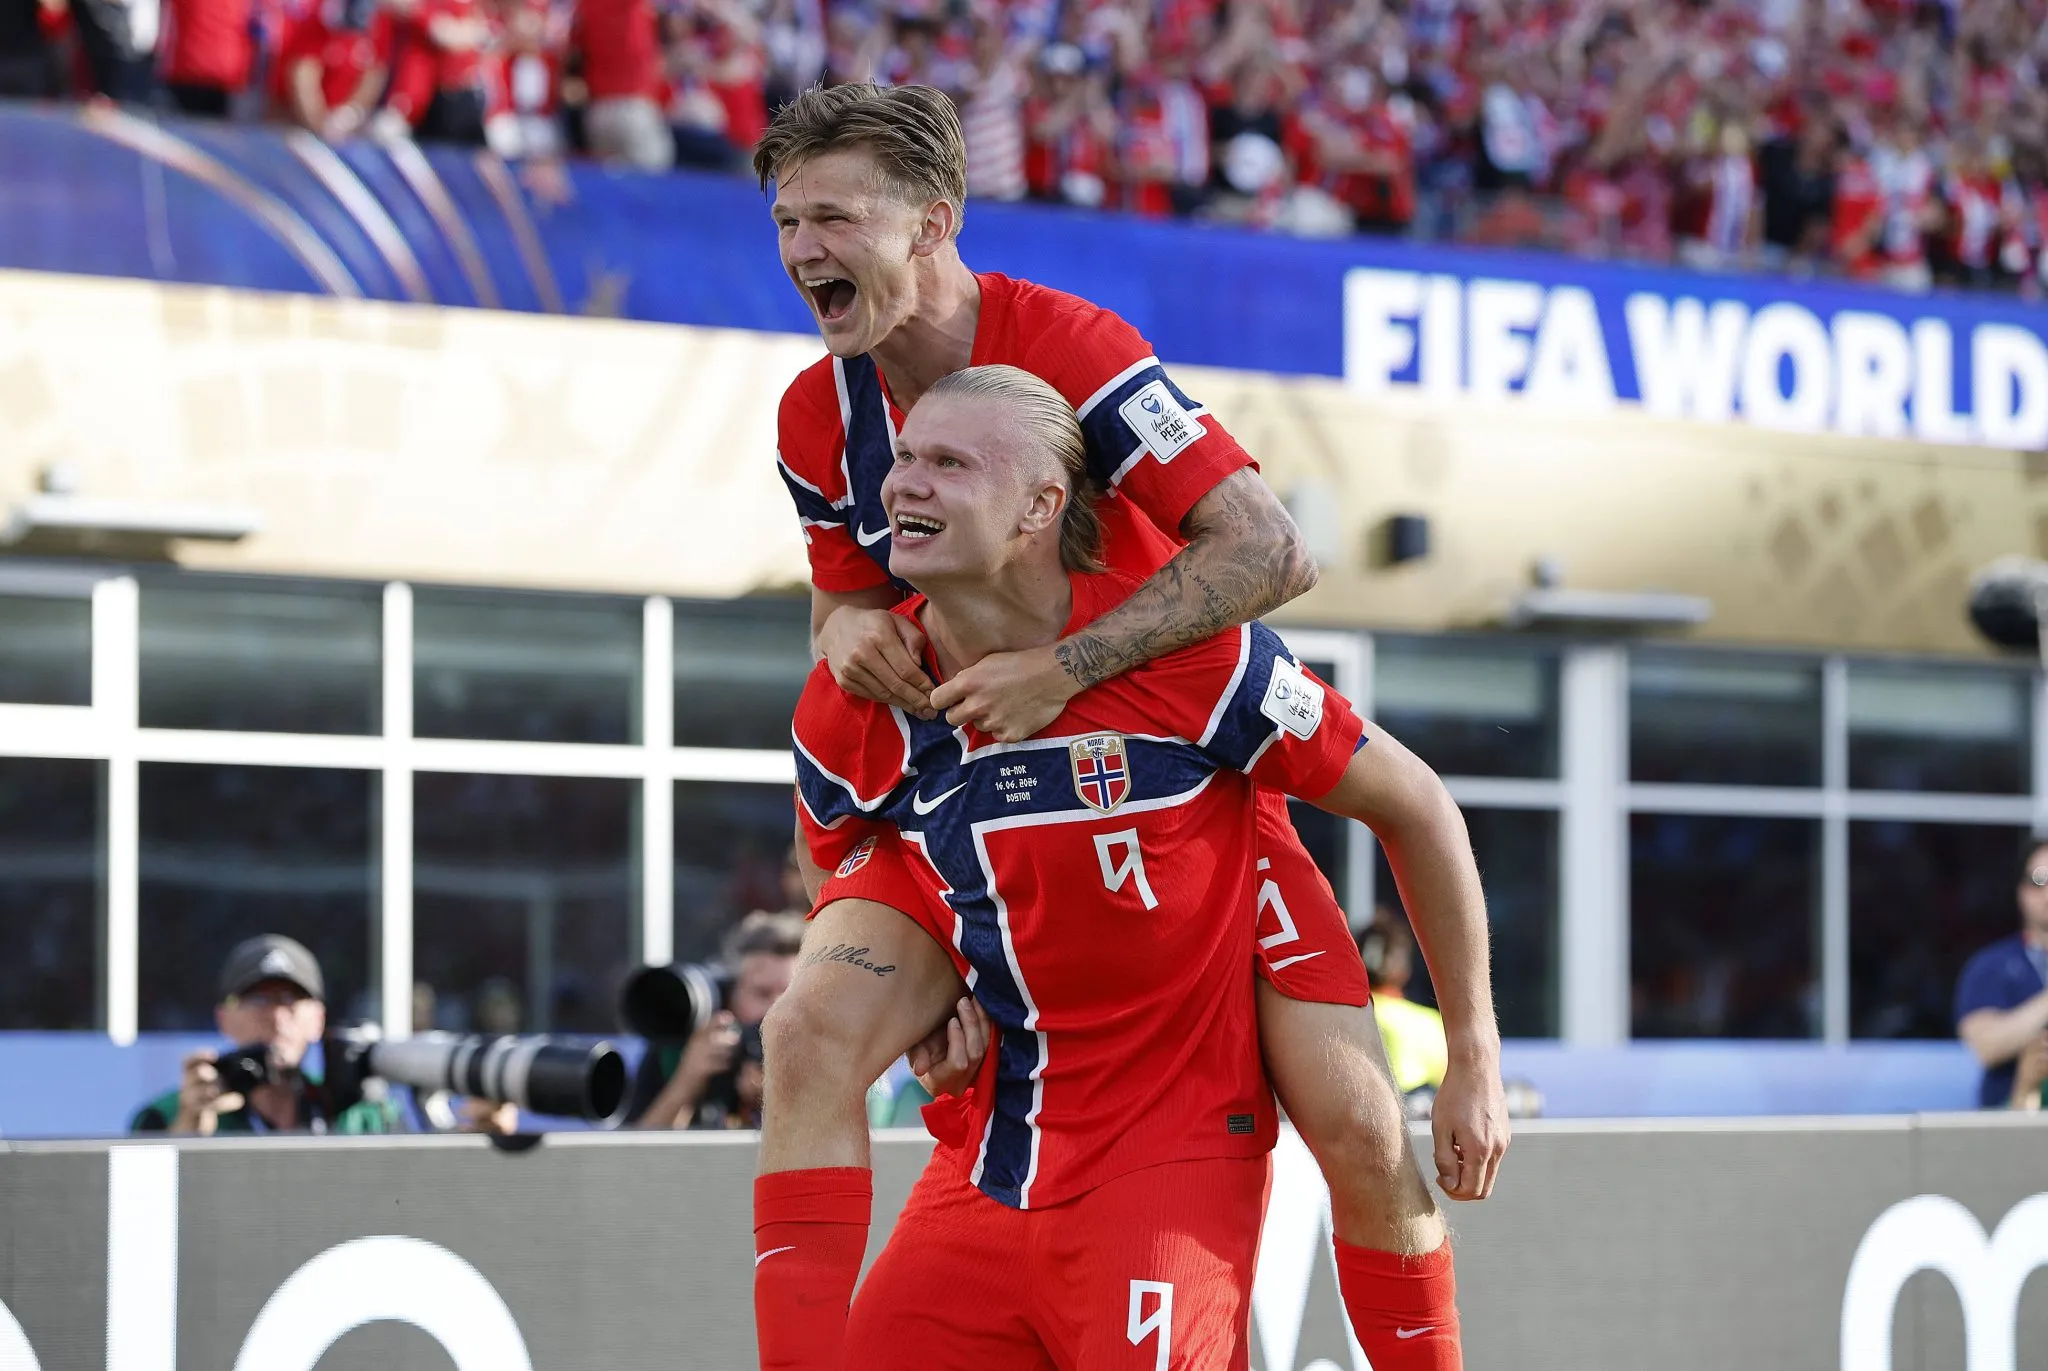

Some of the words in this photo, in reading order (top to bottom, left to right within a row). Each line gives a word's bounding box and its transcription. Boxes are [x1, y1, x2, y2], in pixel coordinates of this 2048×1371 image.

[1343, 267, 1618, 404] FIFA
[1624, 292, 2048, 451] WORLD
[1173, 430, 1189, 444] FIFA
[1087, 738, 1105, 748] NORGE
[1005, 791, 1031, 803] BOSTON
[1093, 828, 1159, 911] 9
[1126, 1279, 1174, 1371] 9
